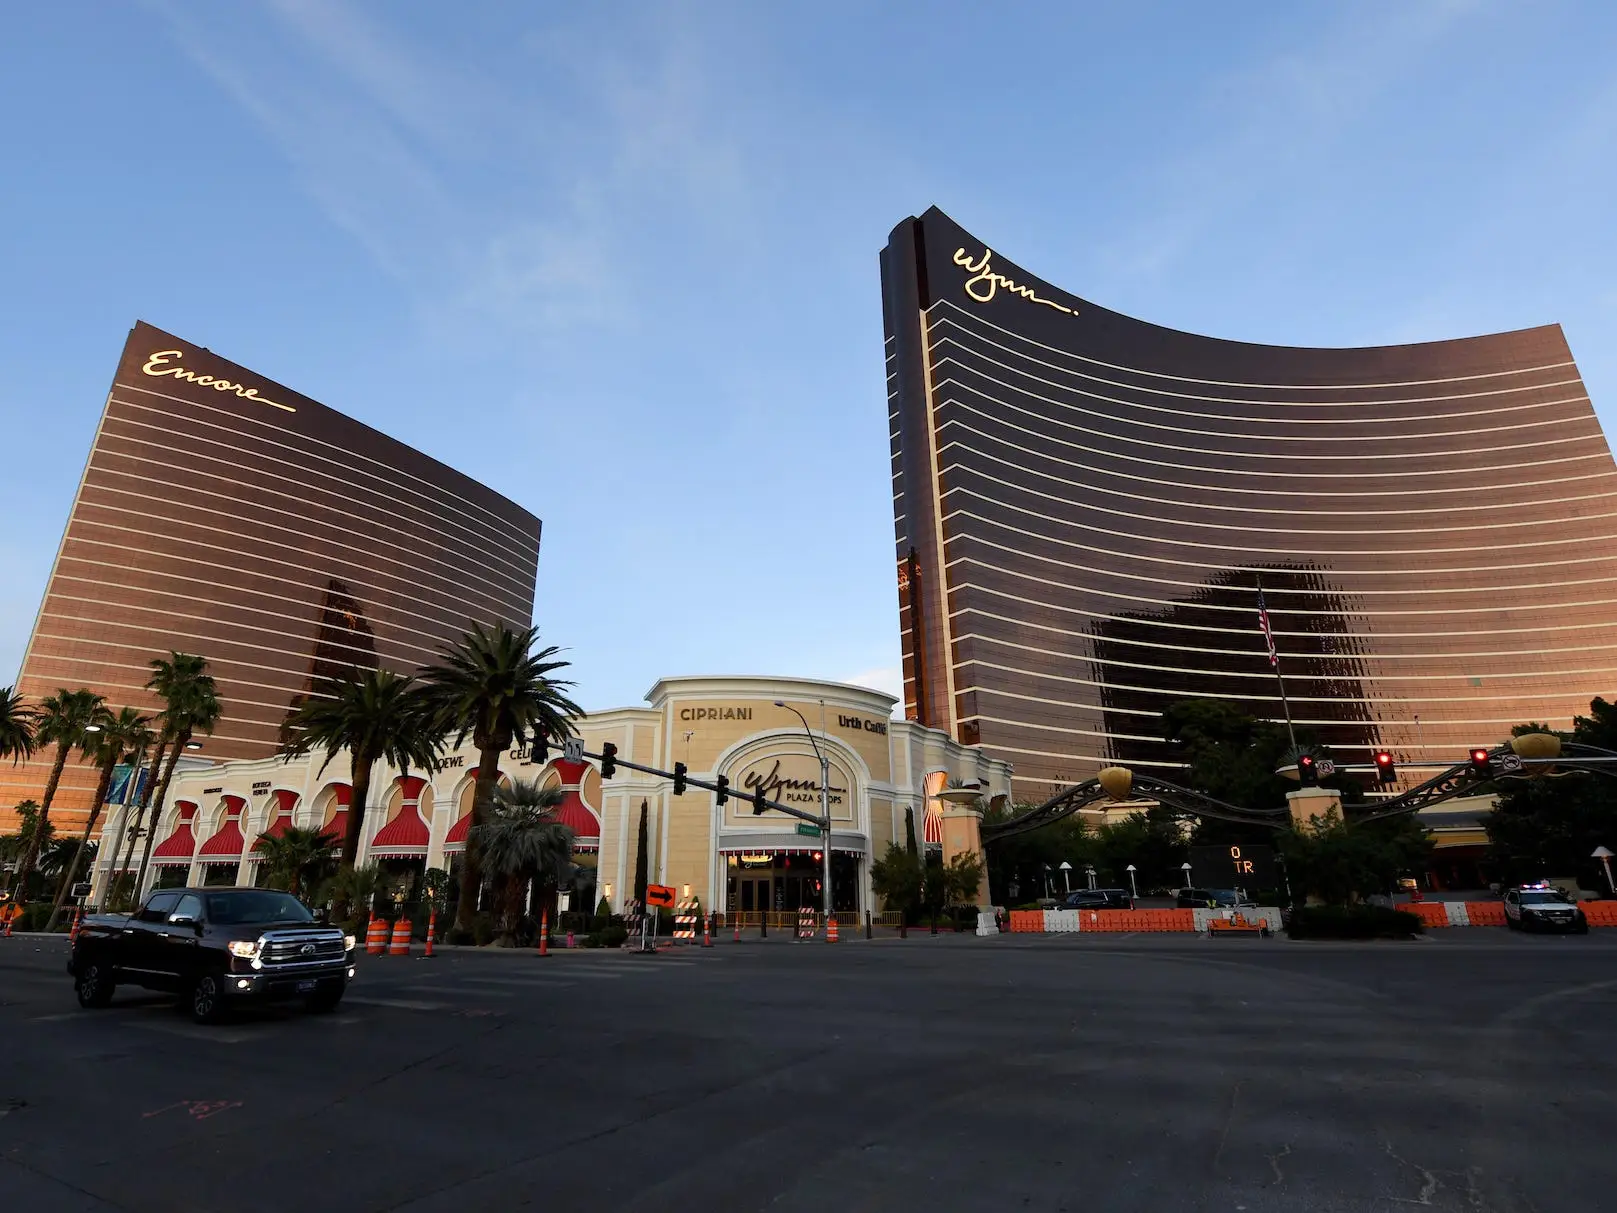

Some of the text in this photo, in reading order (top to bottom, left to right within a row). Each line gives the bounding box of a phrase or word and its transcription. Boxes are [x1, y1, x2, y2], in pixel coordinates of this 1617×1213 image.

[142, 350, 297, 413] Encore
[680, 707, 752, 721] CIPRIANI
[838, 715, 862, 730] Urth
[509, 748, 532, 760] CELI
[786, 793, 843, 804] PLAZA SOPS
